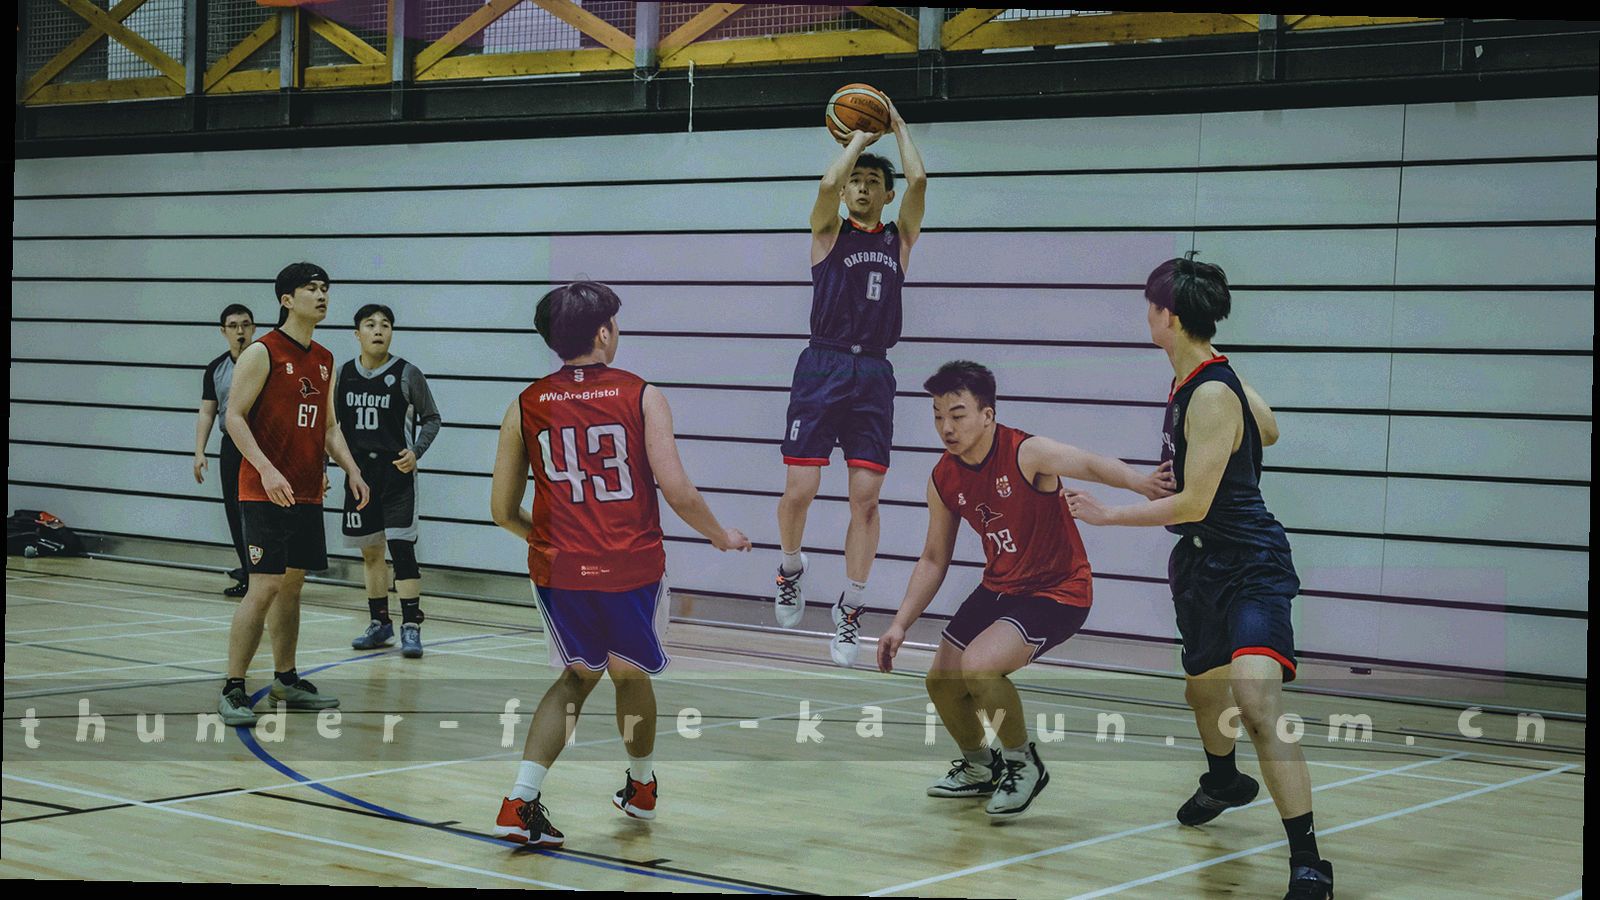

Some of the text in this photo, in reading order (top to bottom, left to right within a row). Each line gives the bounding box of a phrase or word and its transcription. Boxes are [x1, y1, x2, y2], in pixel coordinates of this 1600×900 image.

[866, 271, 882, 301] 6
[346, 391, 391, 409] Oxford
[539, 388, 619, 402] #WeAreBristol
[297, 403, 318, 428] 67
[355, 407, 379, 430] 10
[789, 419, 801, 441] 6
[537, 423, 634, 504] 43
[346, 511, 362, 528] 10
